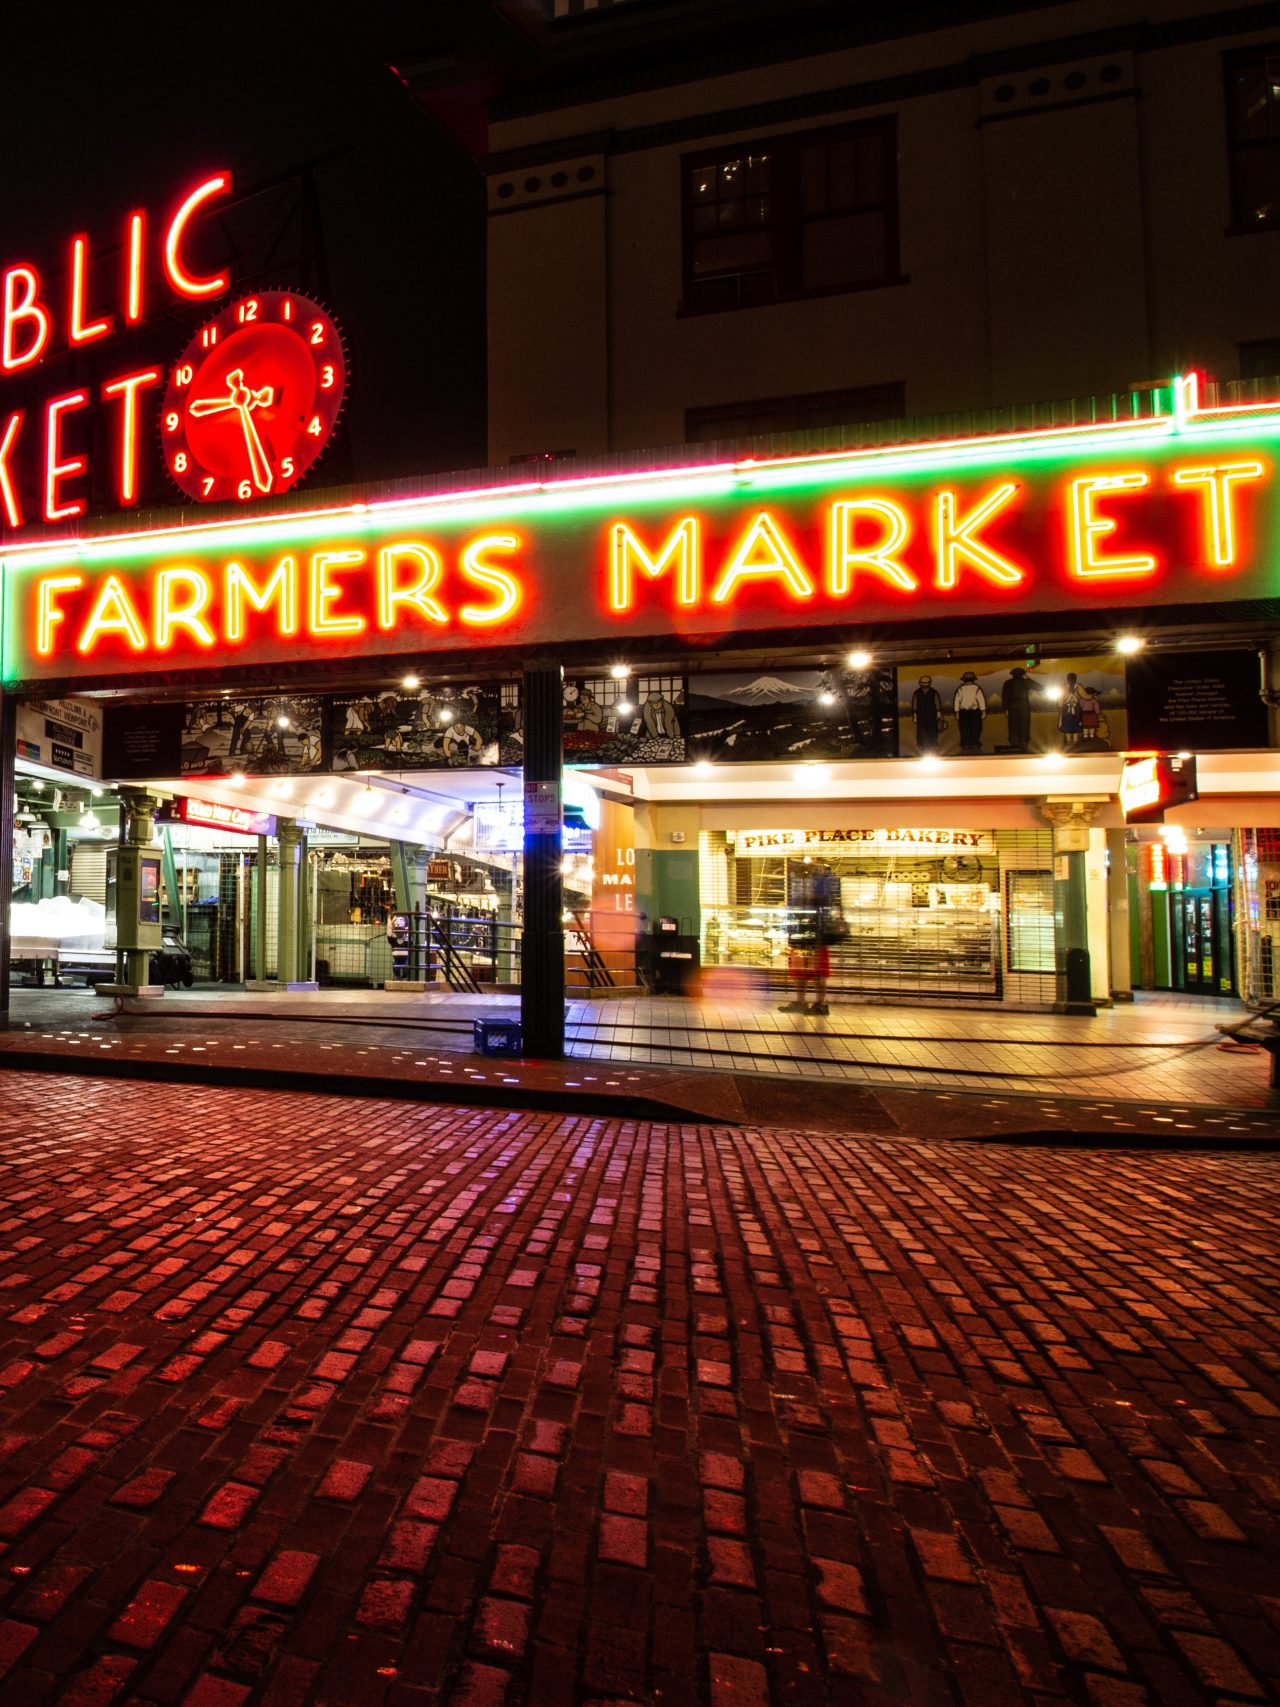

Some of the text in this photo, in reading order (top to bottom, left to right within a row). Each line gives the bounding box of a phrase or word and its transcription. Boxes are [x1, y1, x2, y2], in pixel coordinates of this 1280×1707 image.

[239, 300, 258, 323] 12
[284, 301, 291, 320] 1
[202, 326, 217, 347] 11
[310, 323, 324, 344] 2
[176, 365, 193, 386] 10
[321, 366, 334, 388] 3
[166, 412, 179, 431] 9
[307, 416, 322, 436] 4
[174, 453, 187, 472] 8
[281, 457, 294, 477] 5
[203, 477, 215, 496] 7
[238, 480, 251, 499] 6
[35, 460, 1265, 654] FARMERS MARKET
[525, 784, 537, 793] NO
[528, 793, 556, 803] STOPS
[744, 828, 985, 849] PIKE PLACE BAKERY
[602, 874, 635, 885] MA
[615, 893, 633, 911] LE
